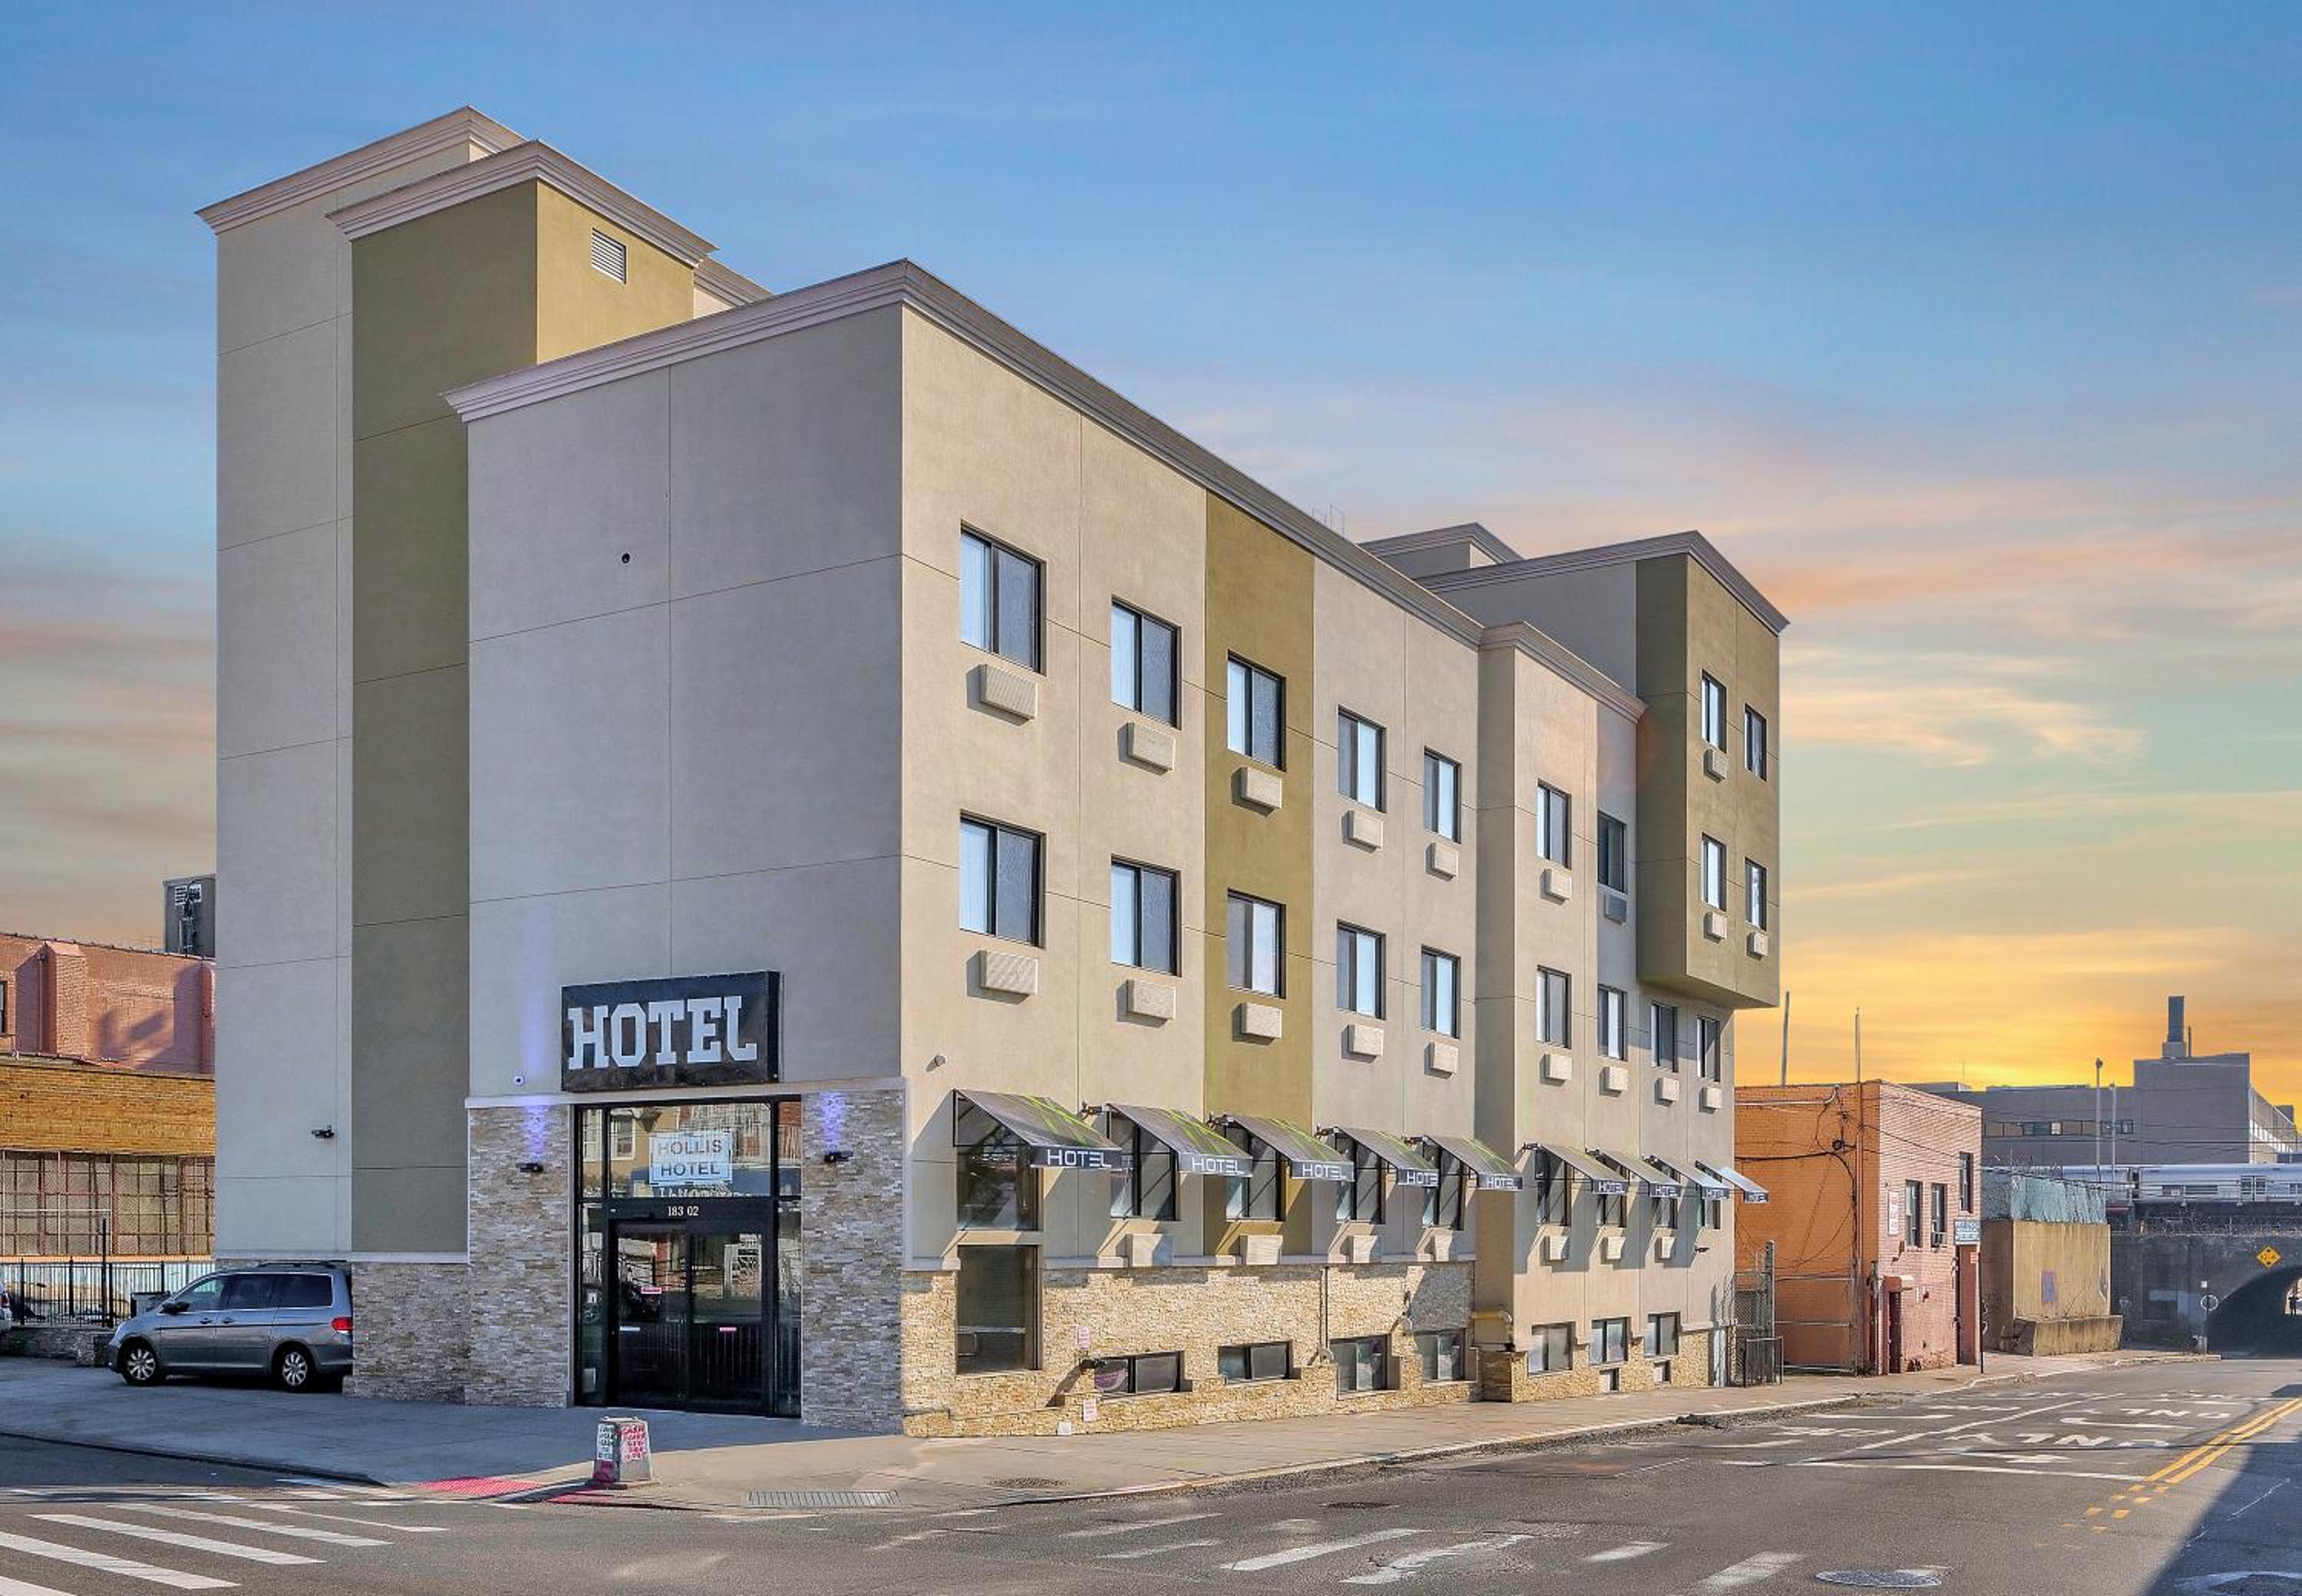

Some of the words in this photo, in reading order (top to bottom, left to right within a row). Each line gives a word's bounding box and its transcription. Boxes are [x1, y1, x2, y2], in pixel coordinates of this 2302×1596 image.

[567, 995, 757, 1070] HOTEL
[658, 1139, 721, 1154] HOLLIS
[1047, 1149, 1112, 1167] HOTEL
[1192, 1157, 1245, 1174] HOTEL
[661, 1162, 721, 1176] HOTEL
[1302, 1163, 1347, 1179] HOTEL
[1486, 1176, 1519, 1190] HOTEL
[1598, 1181, 1626, 1193] HOTEL
[668, 1205, 684, 1216] 183
[687, 1205, 699, 1216] 02
